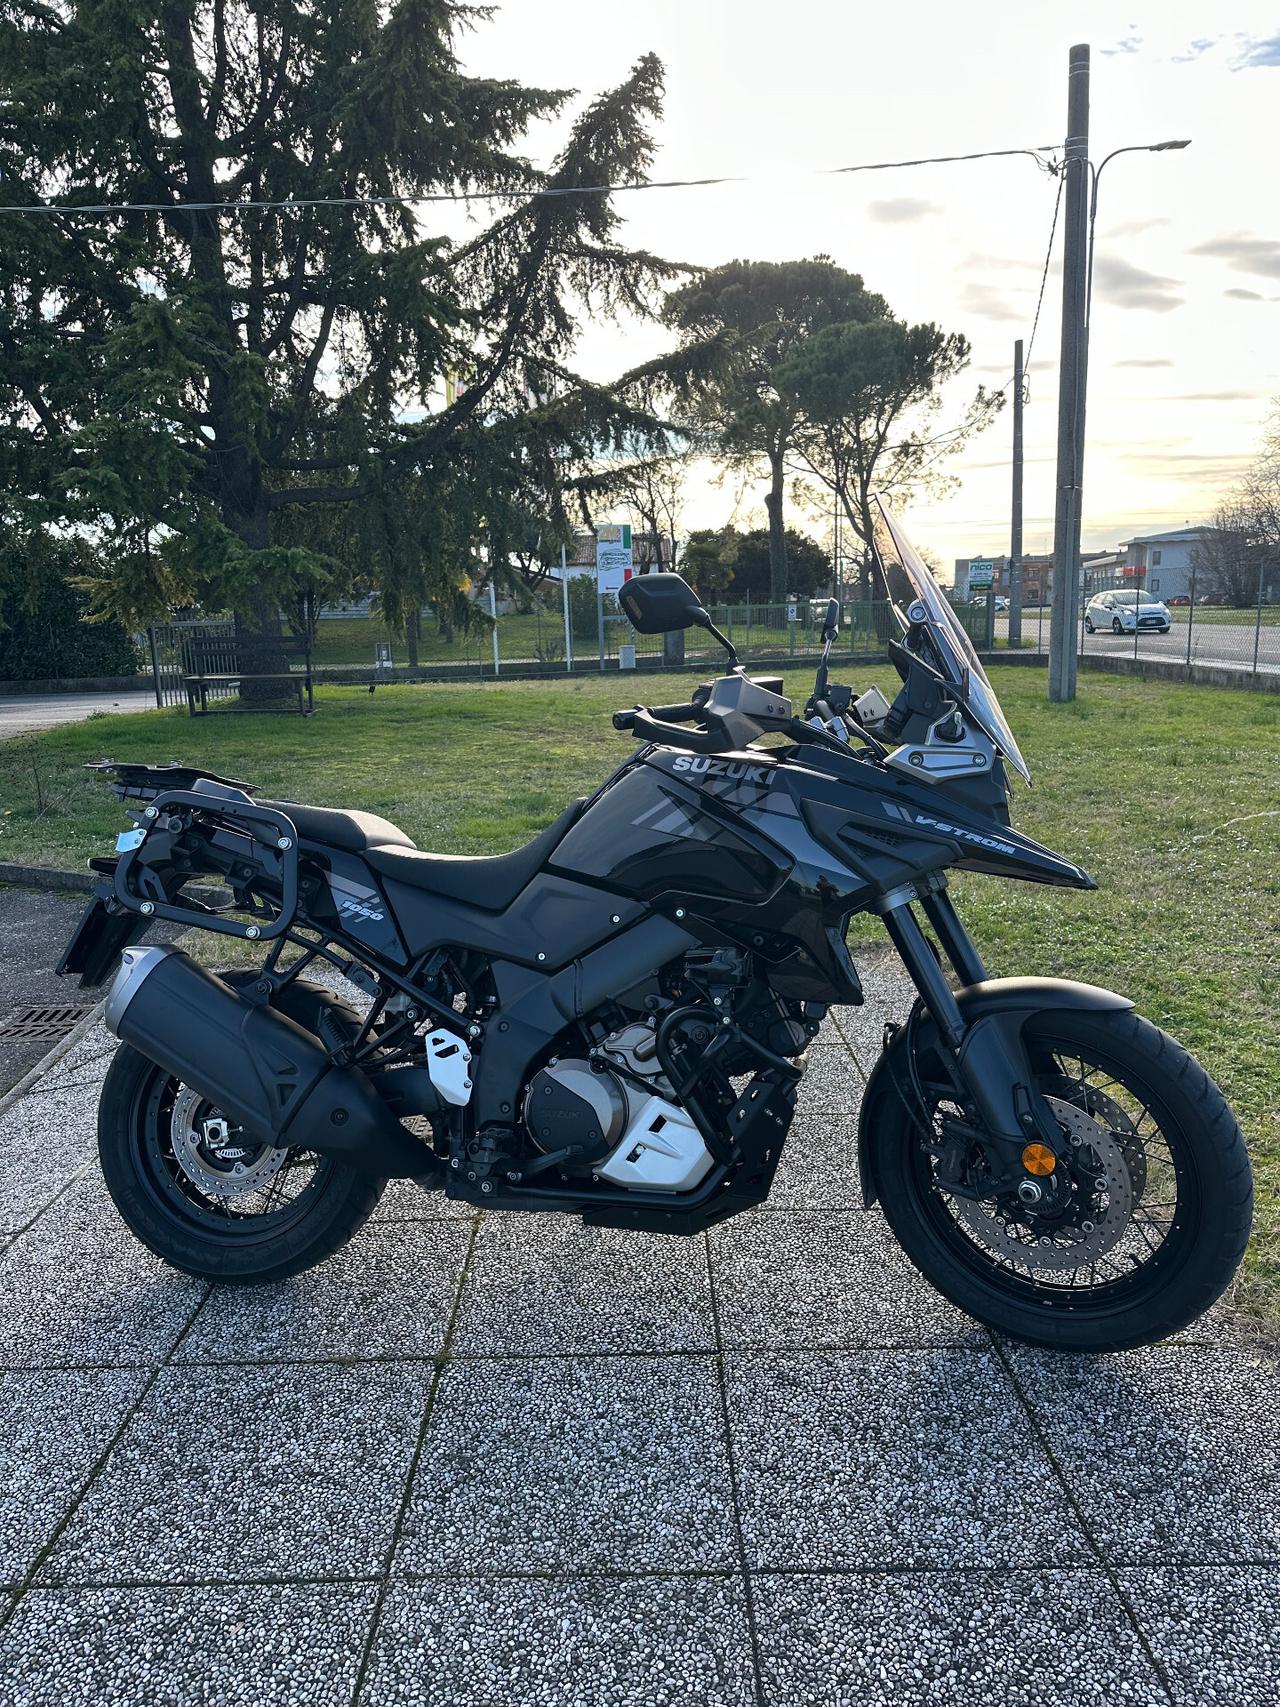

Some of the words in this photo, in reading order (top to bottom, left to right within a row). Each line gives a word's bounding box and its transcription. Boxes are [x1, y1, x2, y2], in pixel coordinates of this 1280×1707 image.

[970, 562, 992, 571] nico
[672, 756, 777, 785] SUZUKI
[915, 815, 1016, 855] V-STROM
[342, 900, 384, 921] 1050
